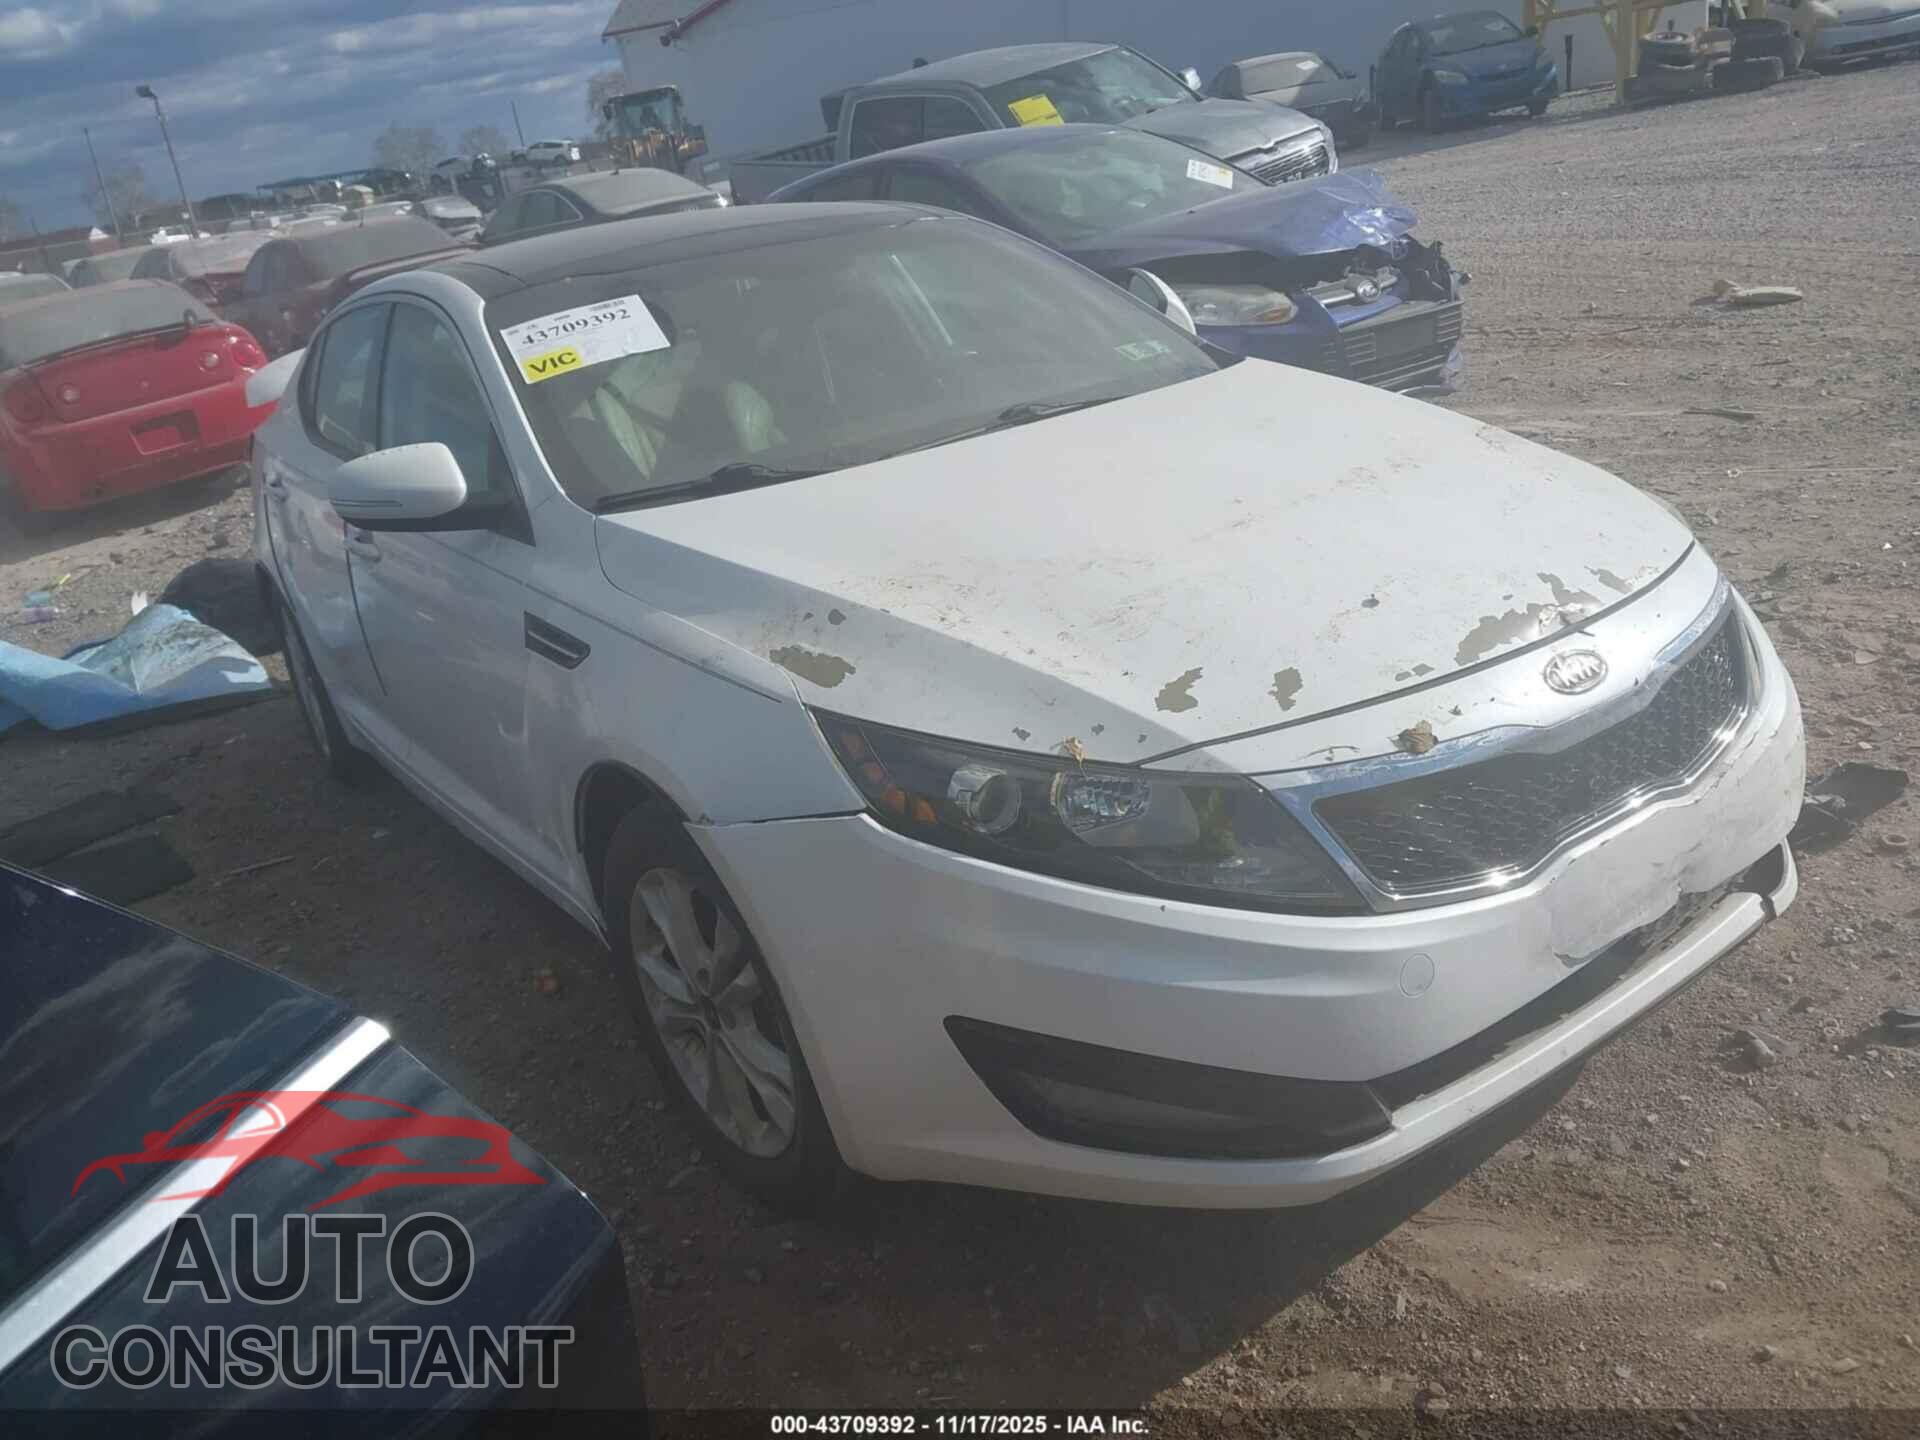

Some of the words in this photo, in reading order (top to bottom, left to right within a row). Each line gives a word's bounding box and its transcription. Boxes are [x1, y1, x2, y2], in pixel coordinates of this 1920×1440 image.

[522, 308, 631, 345] 43709392
[529, 351, 577, 374] VIC
[1550, 655, 1602, 690] KIA
